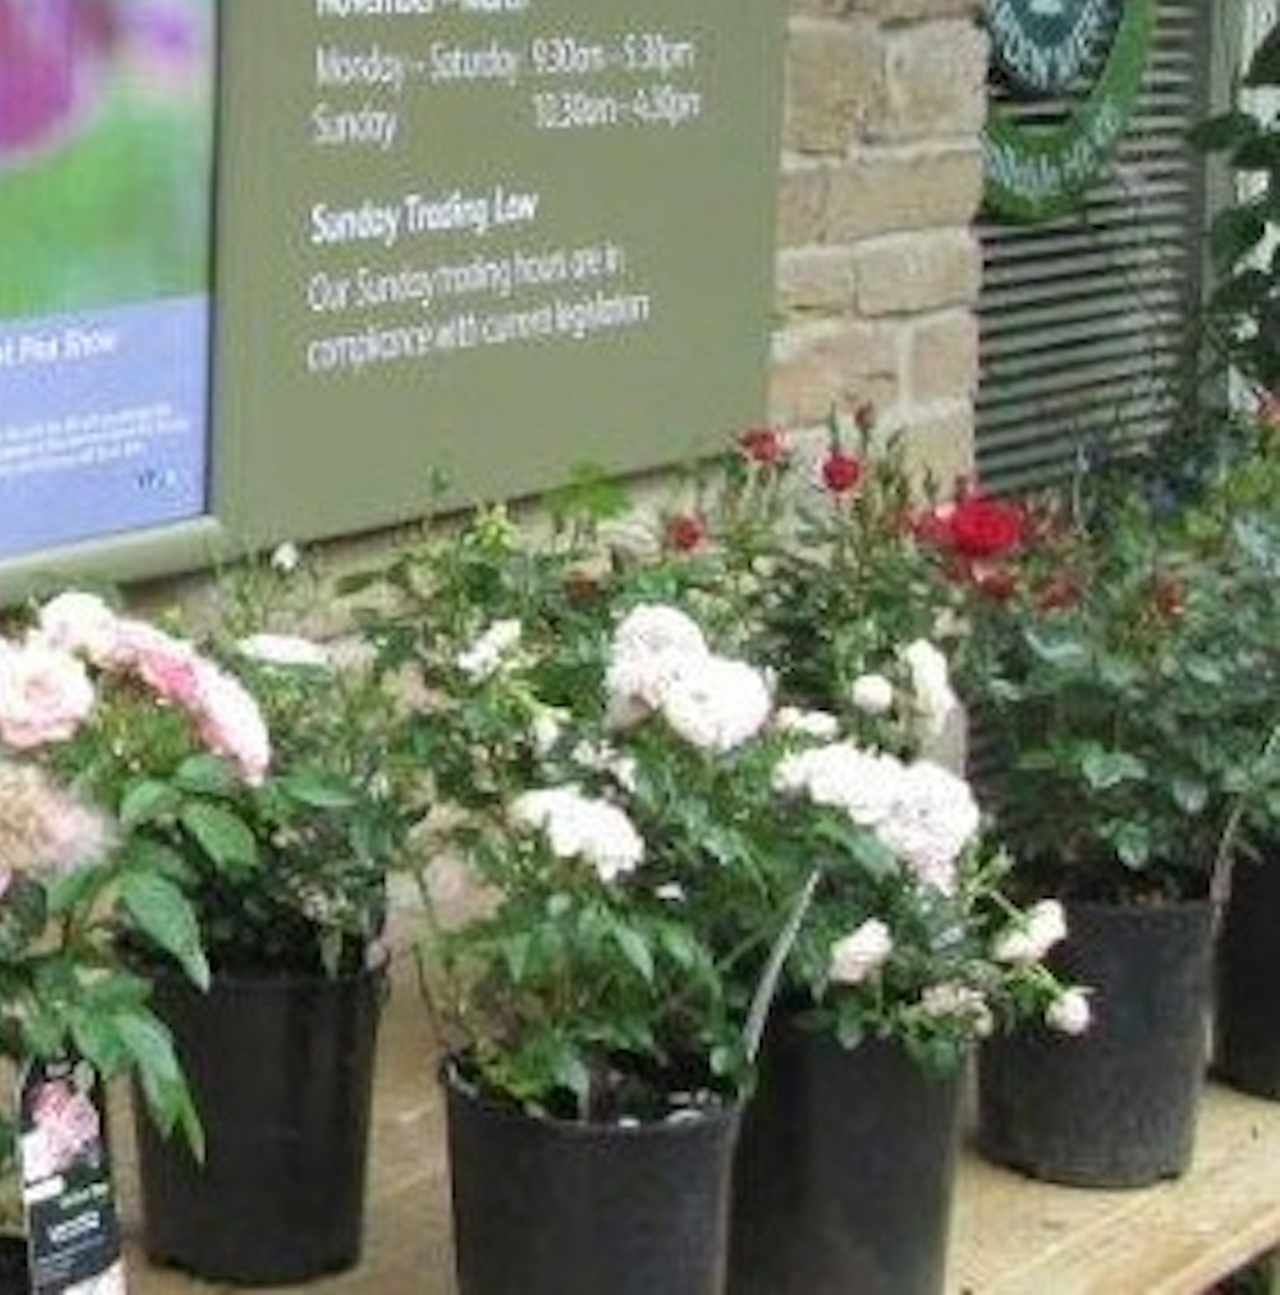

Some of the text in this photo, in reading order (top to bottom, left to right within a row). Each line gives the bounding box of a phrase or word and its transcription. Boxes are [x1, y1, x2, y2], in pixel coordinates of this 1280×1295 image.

[316, 42, 406, 91] Monday
[311, 102, 397, 150] Sunday
[311, 184, 538, 247] Sunday Trading Law
